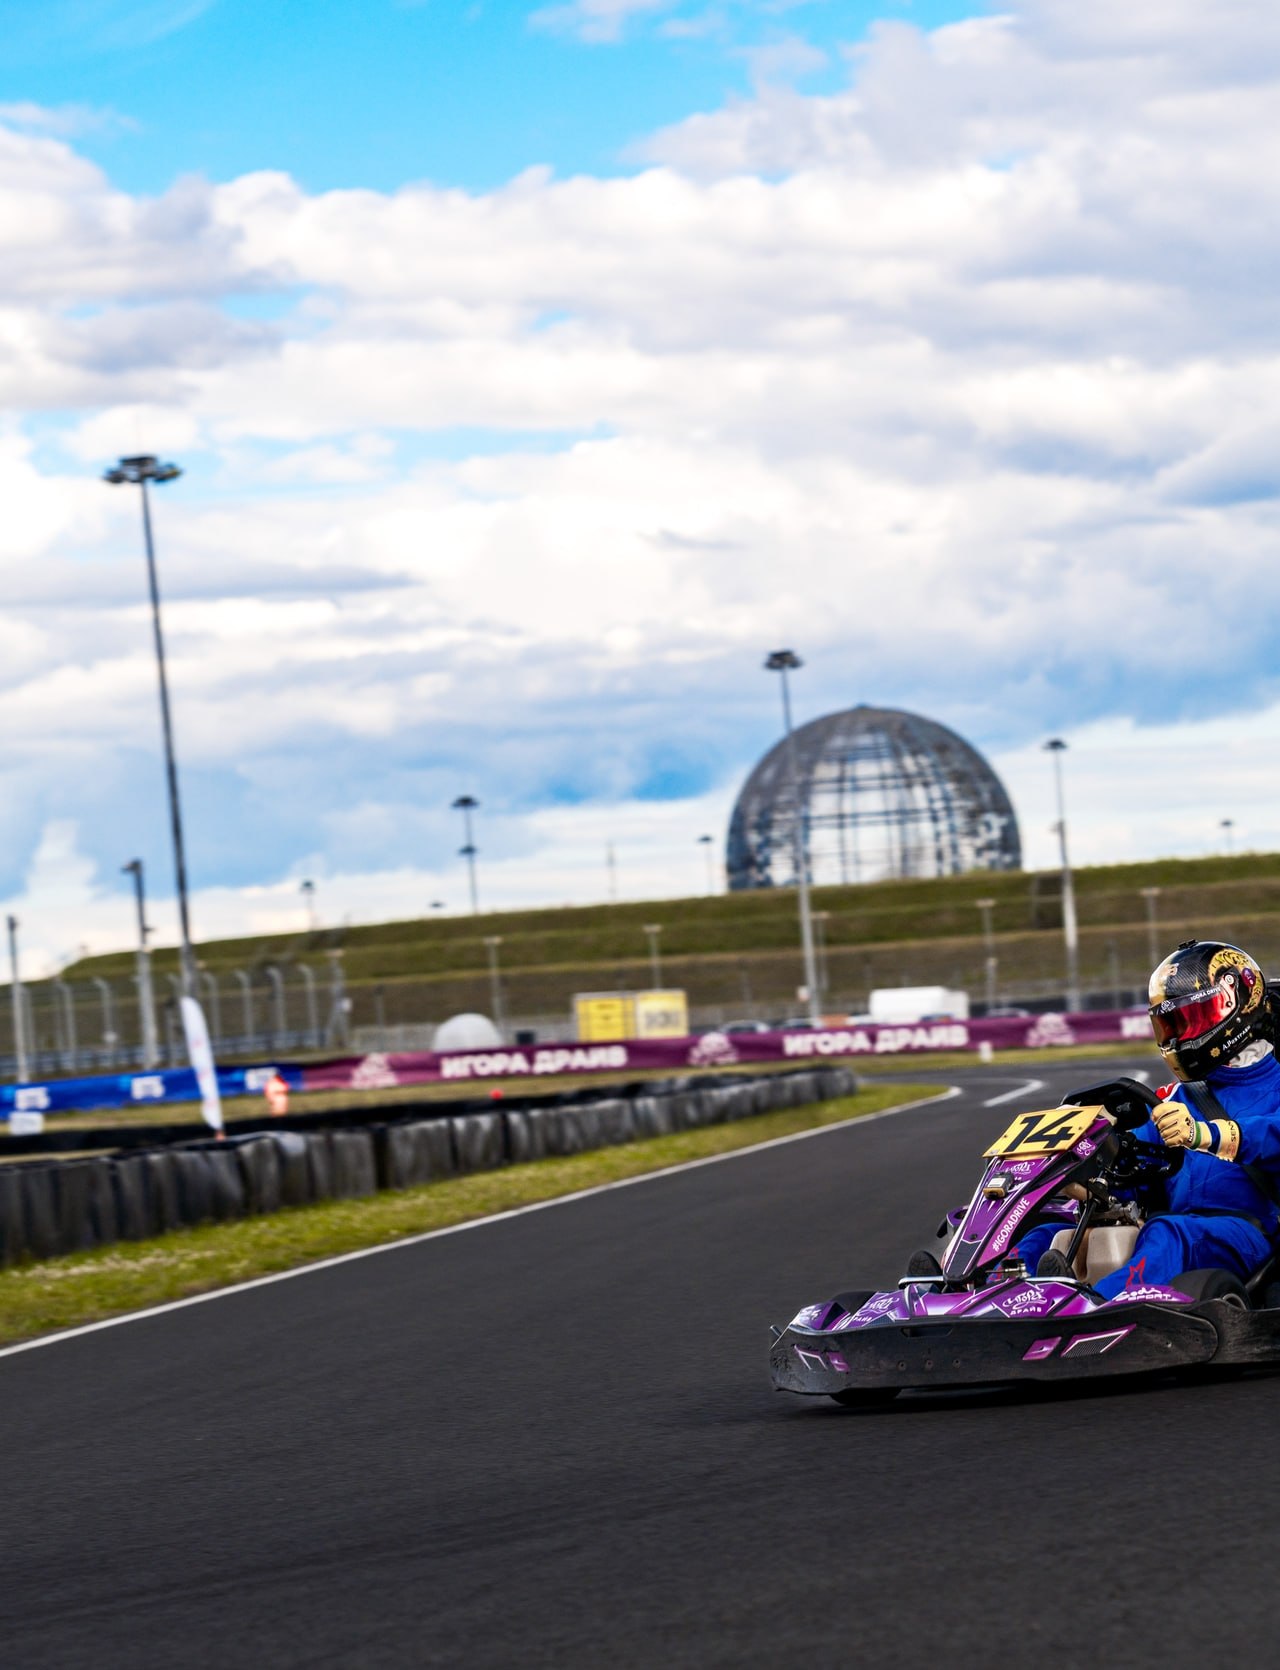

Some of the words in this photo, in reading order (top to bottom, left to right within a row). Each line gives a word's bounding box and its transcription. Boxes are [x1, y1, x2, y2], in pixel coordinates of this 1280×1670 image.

[783, 1031, 871, 1056] ИГОРА
[874, 1024, 968, 1052] ДРАЙВ
[440, 1052, 529, 1078] ИГОРА
[532, 1046, 628, 1075] ДРАЙВ
[1002, 1110, 1084, 1153] 14
[992, 1197, 1031, 1252] #IGORADRIVE
